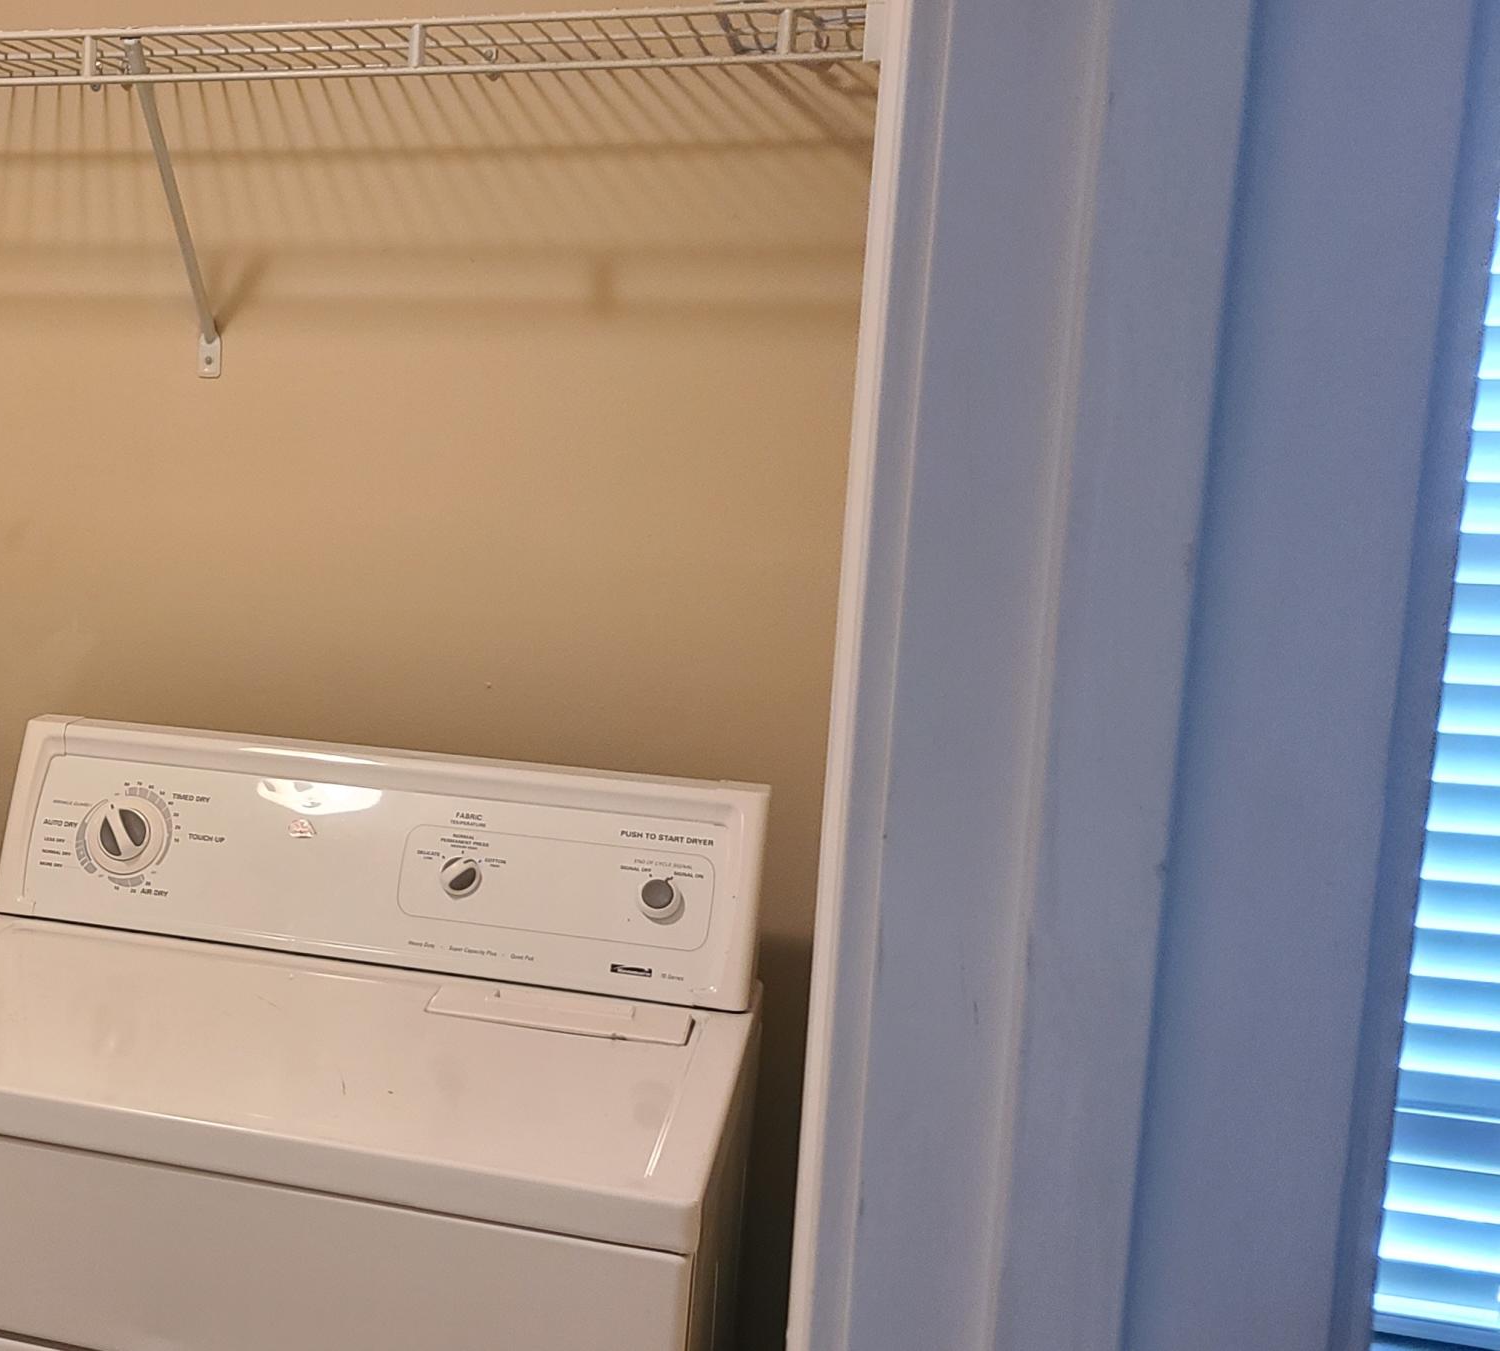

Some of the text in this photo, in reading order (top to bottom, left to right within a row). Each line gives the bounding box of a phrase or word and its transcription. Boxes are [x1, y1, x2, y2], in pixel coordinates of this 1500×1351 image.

[172, 793, 211, 804] TIMED DRY
[455, 811, 483, 821] FABRIC
[43, 818, 79, 828] AUTO DRY
[188, 833, 213, 842] TOUCH
[620, 830, 714, 846] PUSH TO START DRYER
[140, 887, 152, 895] AIR
